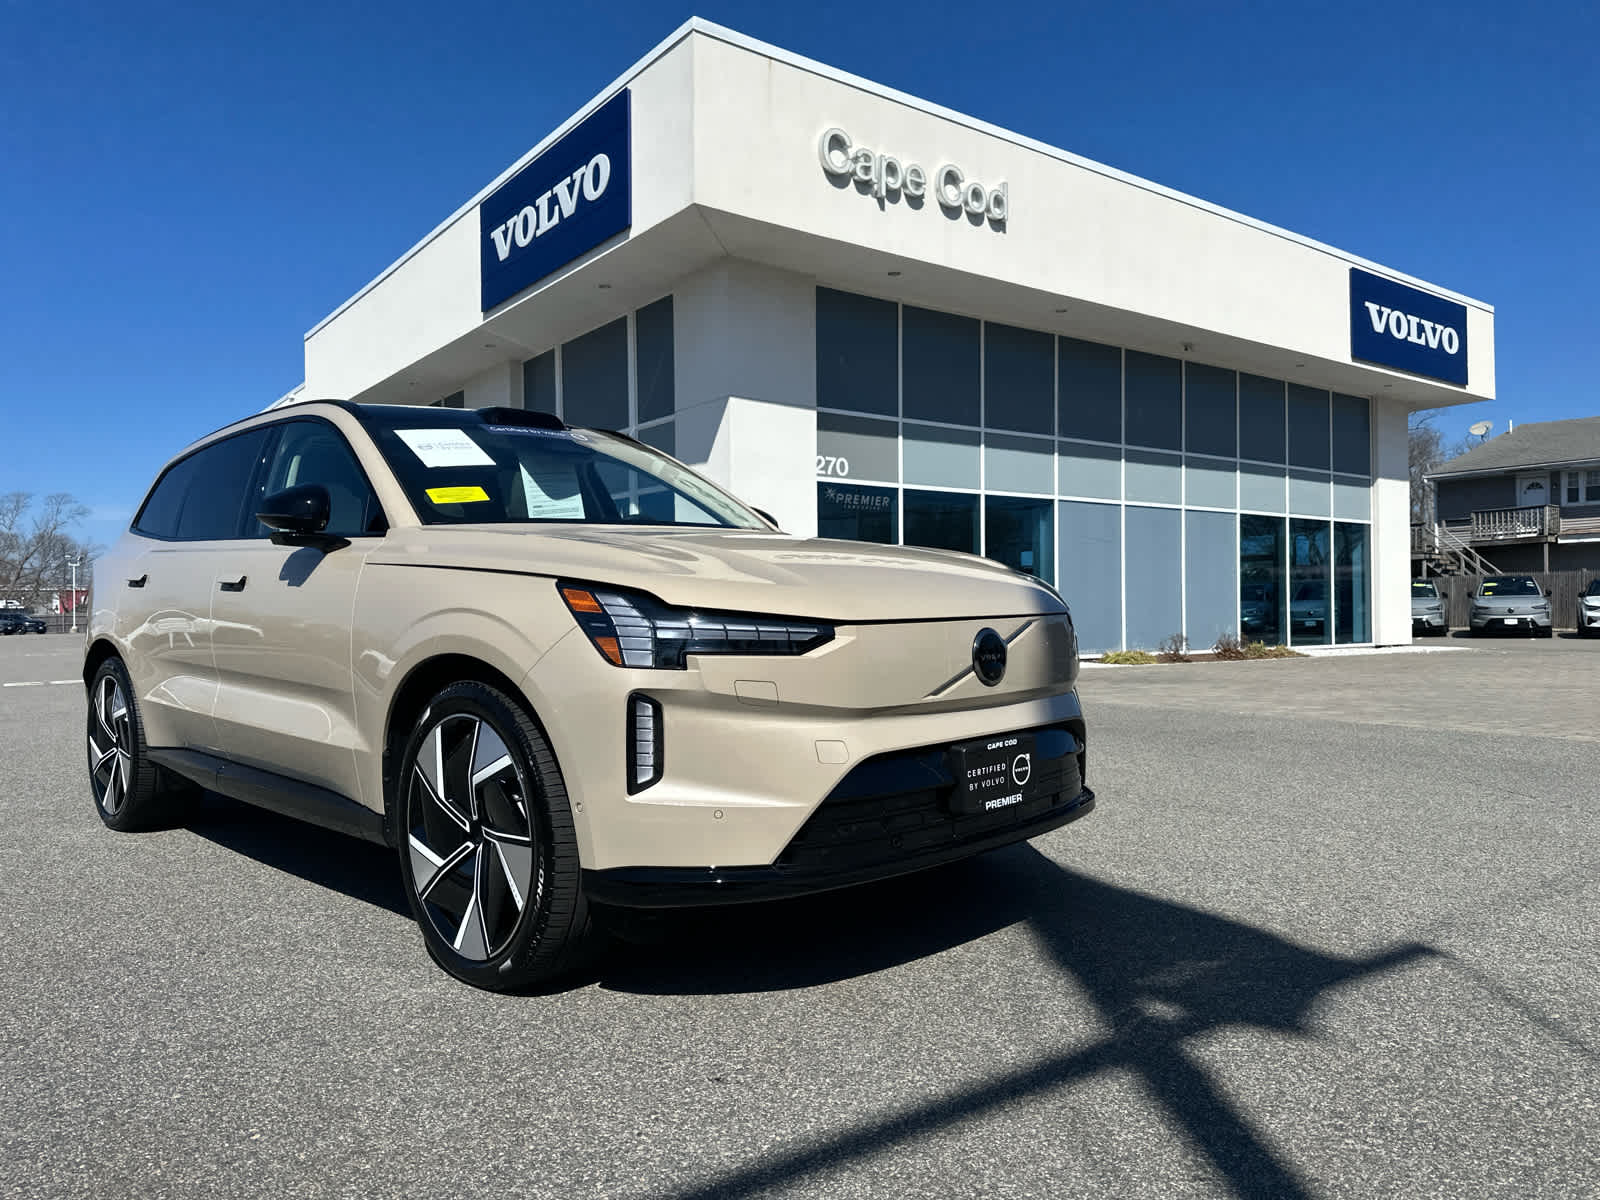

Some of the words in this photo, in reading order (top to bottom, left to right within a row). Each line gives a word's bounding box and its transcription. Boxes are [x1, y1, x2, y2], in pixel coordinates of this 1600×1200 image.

[818, 127, 927, 200] Cape
[935, 163, 1010, 223] Cod
[490, 153, 611, 262] VOLVO
[1364, 301, 1460, 355] VOLVO
[816, 455, 849, 477] 270
[835, 493, 891, 507] PREMIER
[987, 741, 1004, 750] CAPE
[1004, 738, 1018, 747] COD
[967, 762, 1006, 778] CERTIFIED
[969, 782, 979, 791] BY
[981, 776, 1005, 788] VOLVO
[985, 793, 1023, 811] PREMIER
